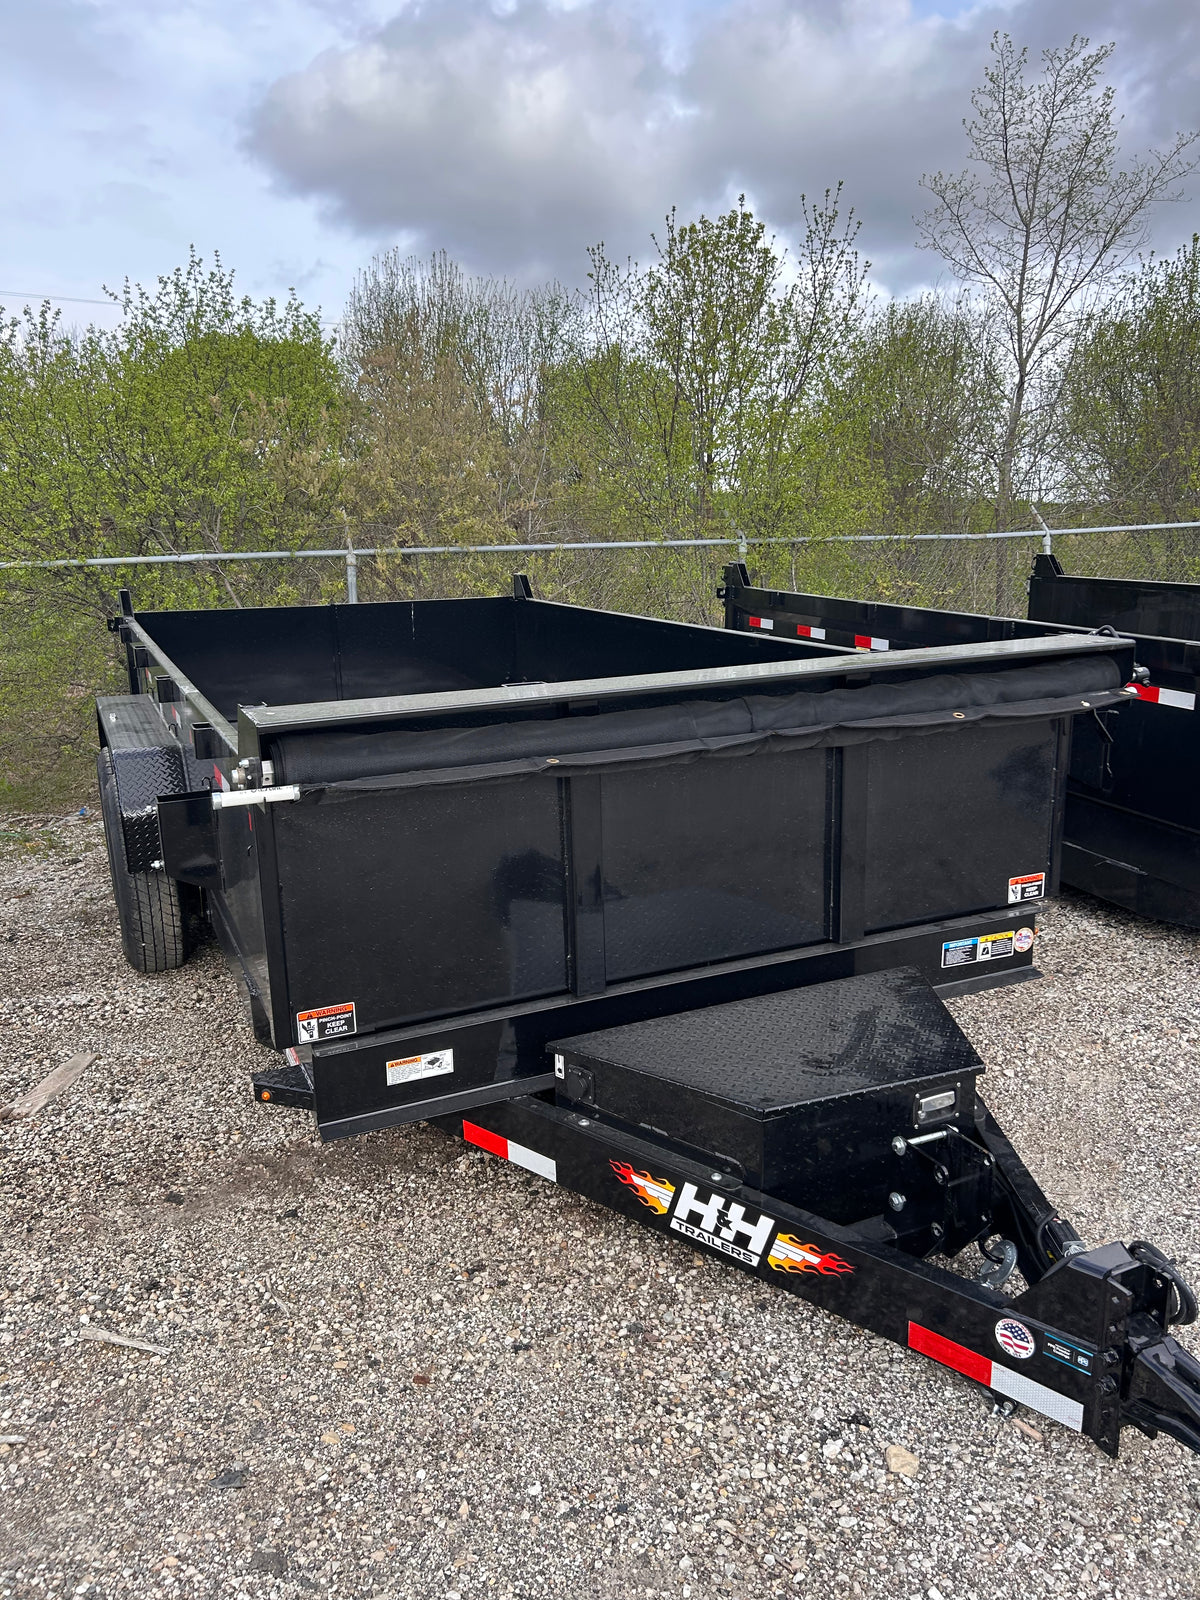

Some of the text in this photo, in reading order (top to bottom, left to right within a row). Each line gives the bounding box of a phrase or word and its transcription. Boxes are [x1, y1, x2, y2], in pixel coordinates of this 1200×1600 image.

[316, 1006, 347, 1017] WARNING
[327, 1020, 345, 1028] KEEP
[325, 1025, 348, 1035] CLEAR
[395, 1057, 418, 1066] WARNING
[676, 1221, 753, 1263] TRAILERS
